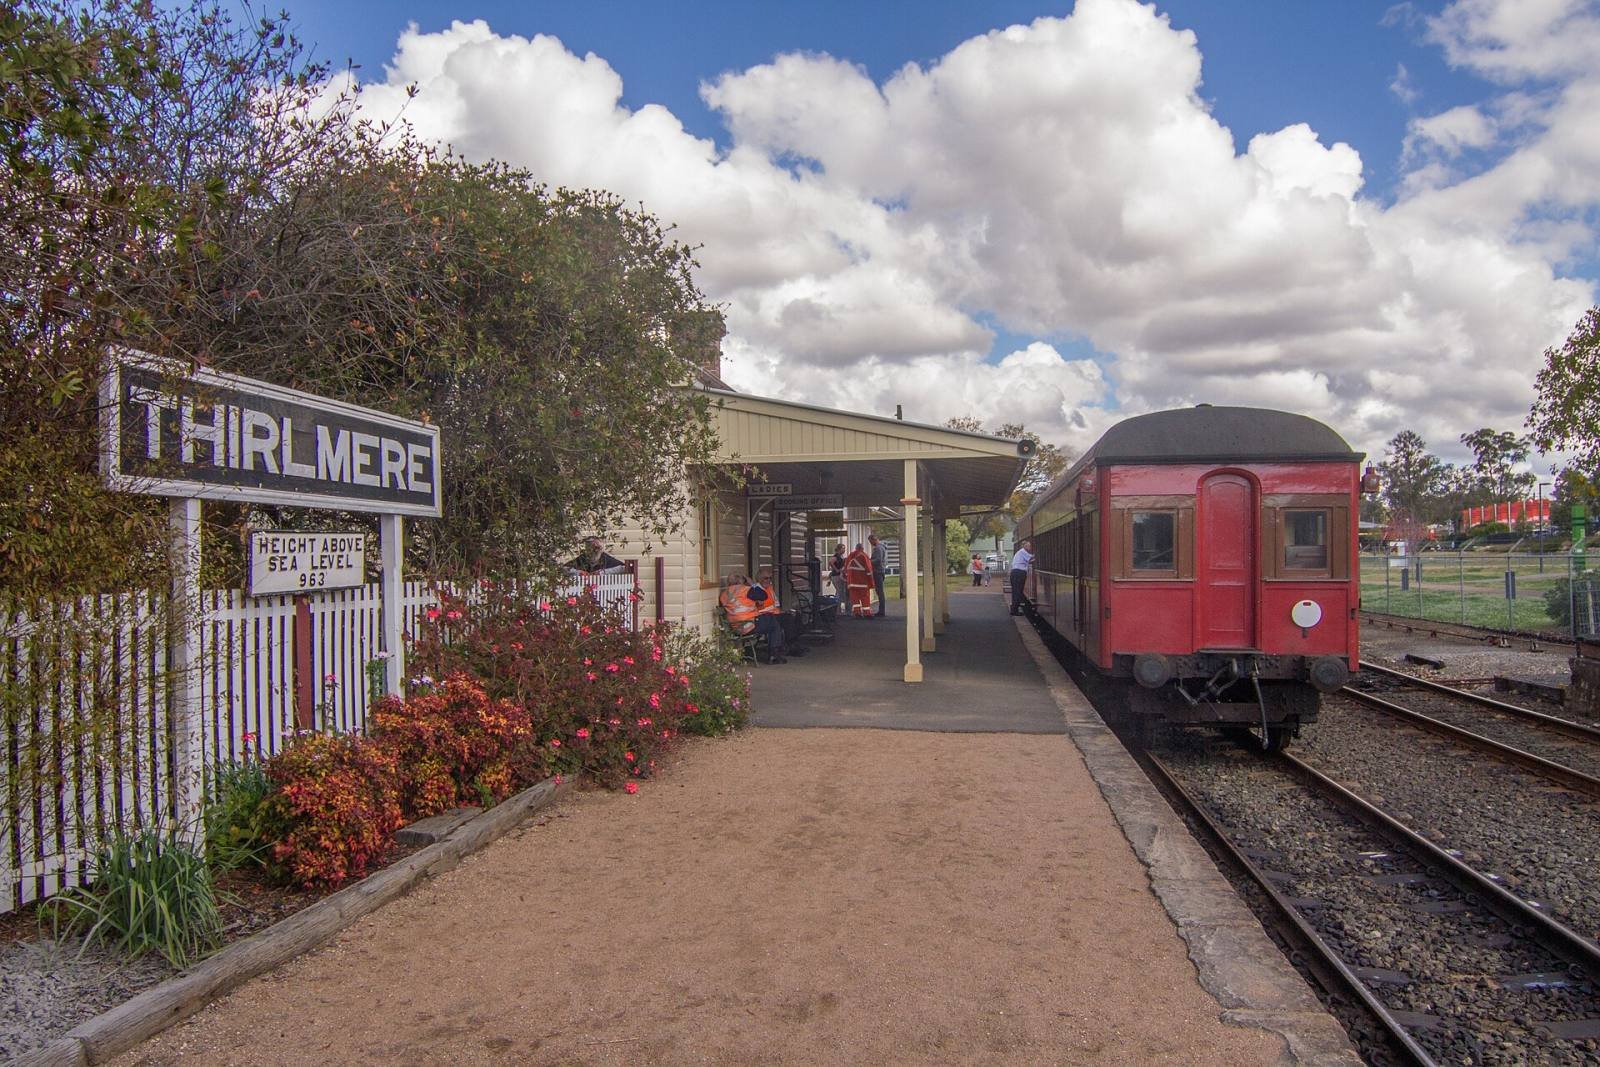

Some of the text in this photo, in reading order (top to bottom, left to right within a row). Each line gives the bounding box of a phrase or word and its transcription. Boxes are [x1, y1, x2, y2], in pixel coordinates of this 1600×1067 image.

[128, 384, 432, 494] THIRLMERE
[259, 537, 362, 554] HEIGHT ABOVE
[268, 554, 353, 571] SEA LEVEL
